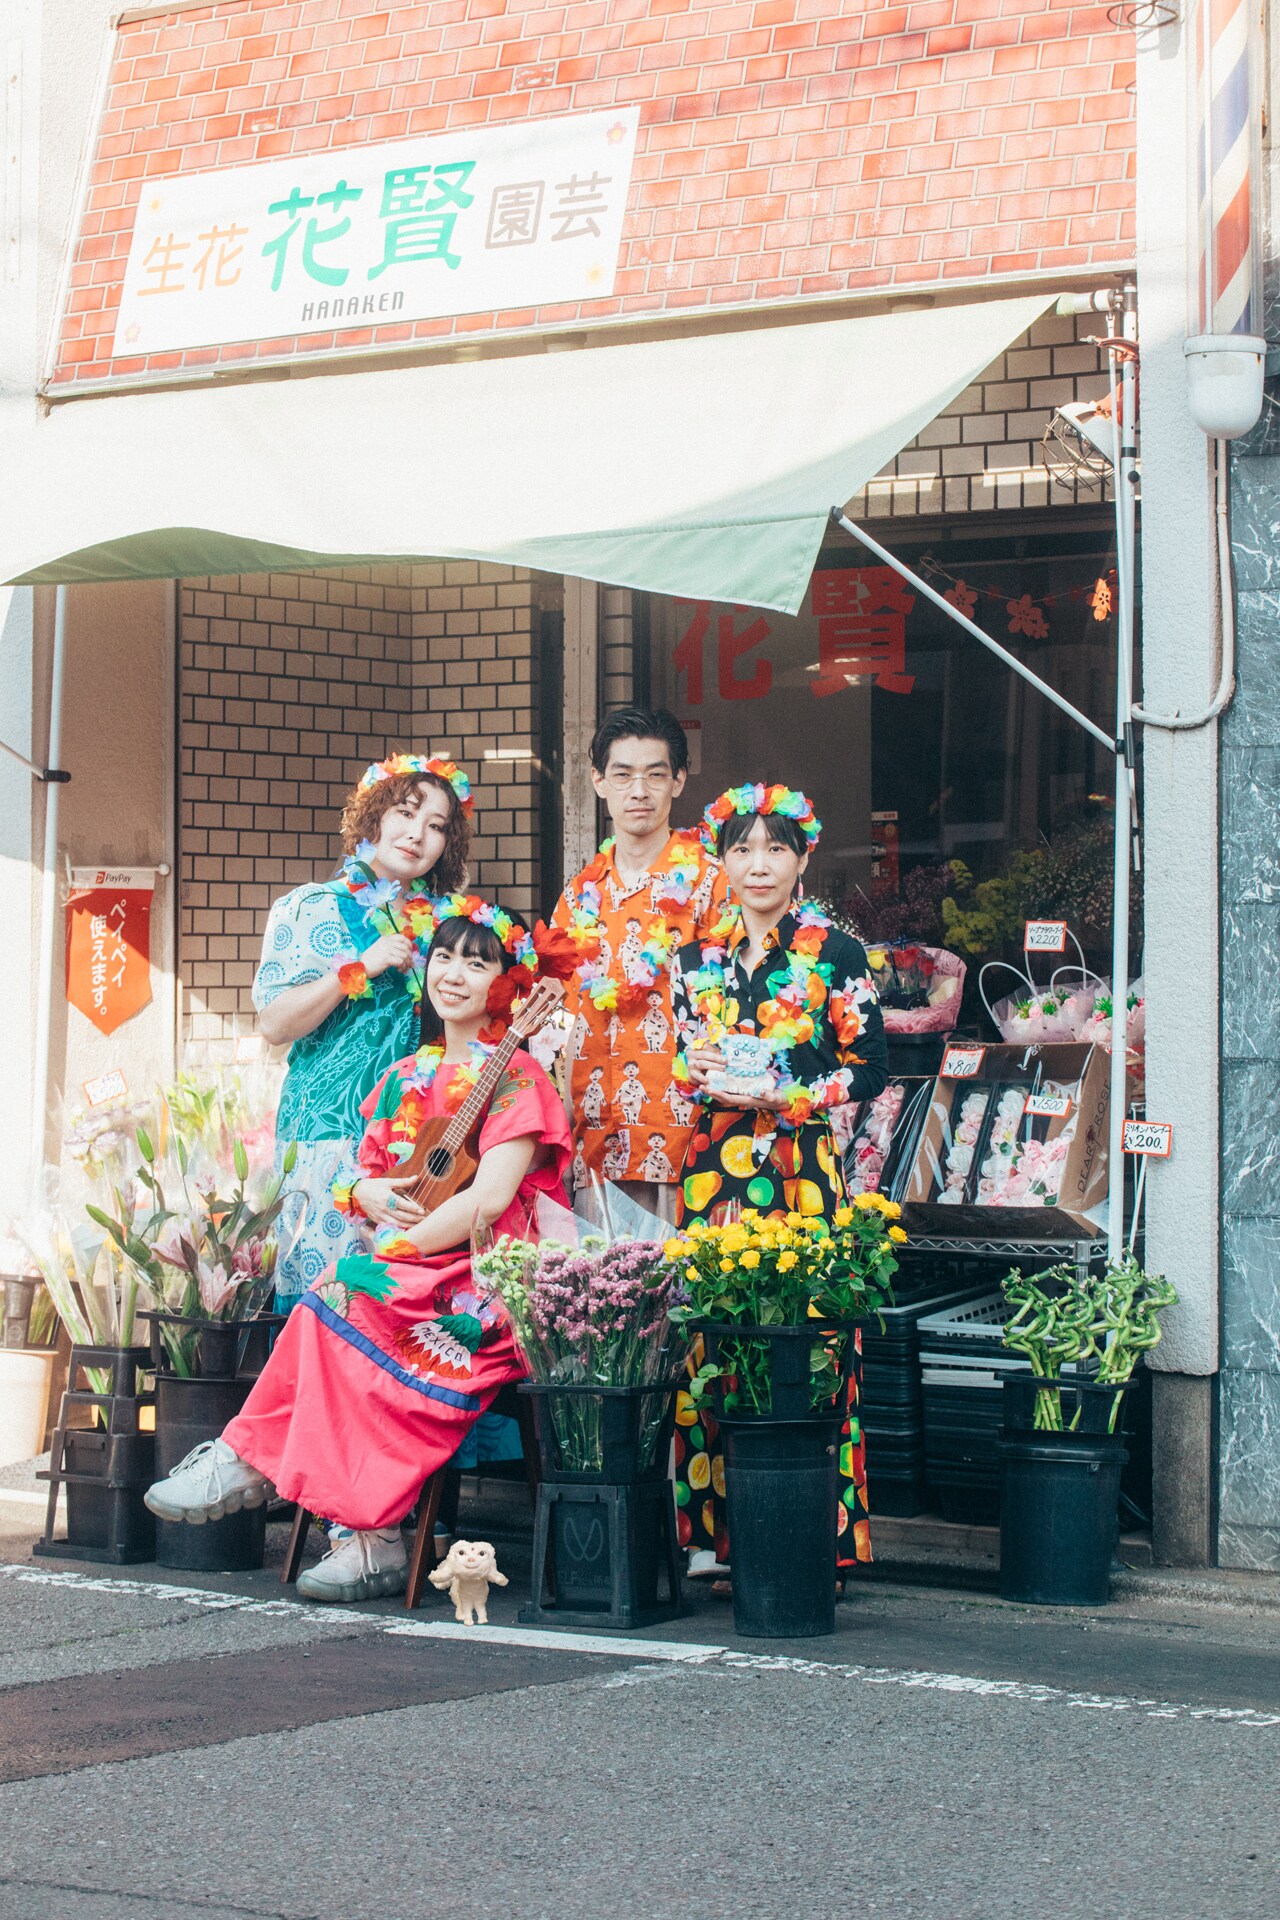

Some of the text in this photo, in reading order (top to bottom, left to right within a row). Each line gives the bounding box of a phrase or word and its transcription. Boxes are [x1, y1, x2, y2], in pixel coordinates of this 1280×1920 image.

[137, 160, 612, 296] 生花 花賢 園芸
[301, 291, 404, 321] HANAKEN
[105, 874, 131, 885] PayPay
[90, 914, 107, 1015] 使えます。
[110, 899, 127, 988] ペイペイ
[1078, 1080, 1111, 1193] DEAR ROSE
[421, 1327, 463, 1362] MEXICO
